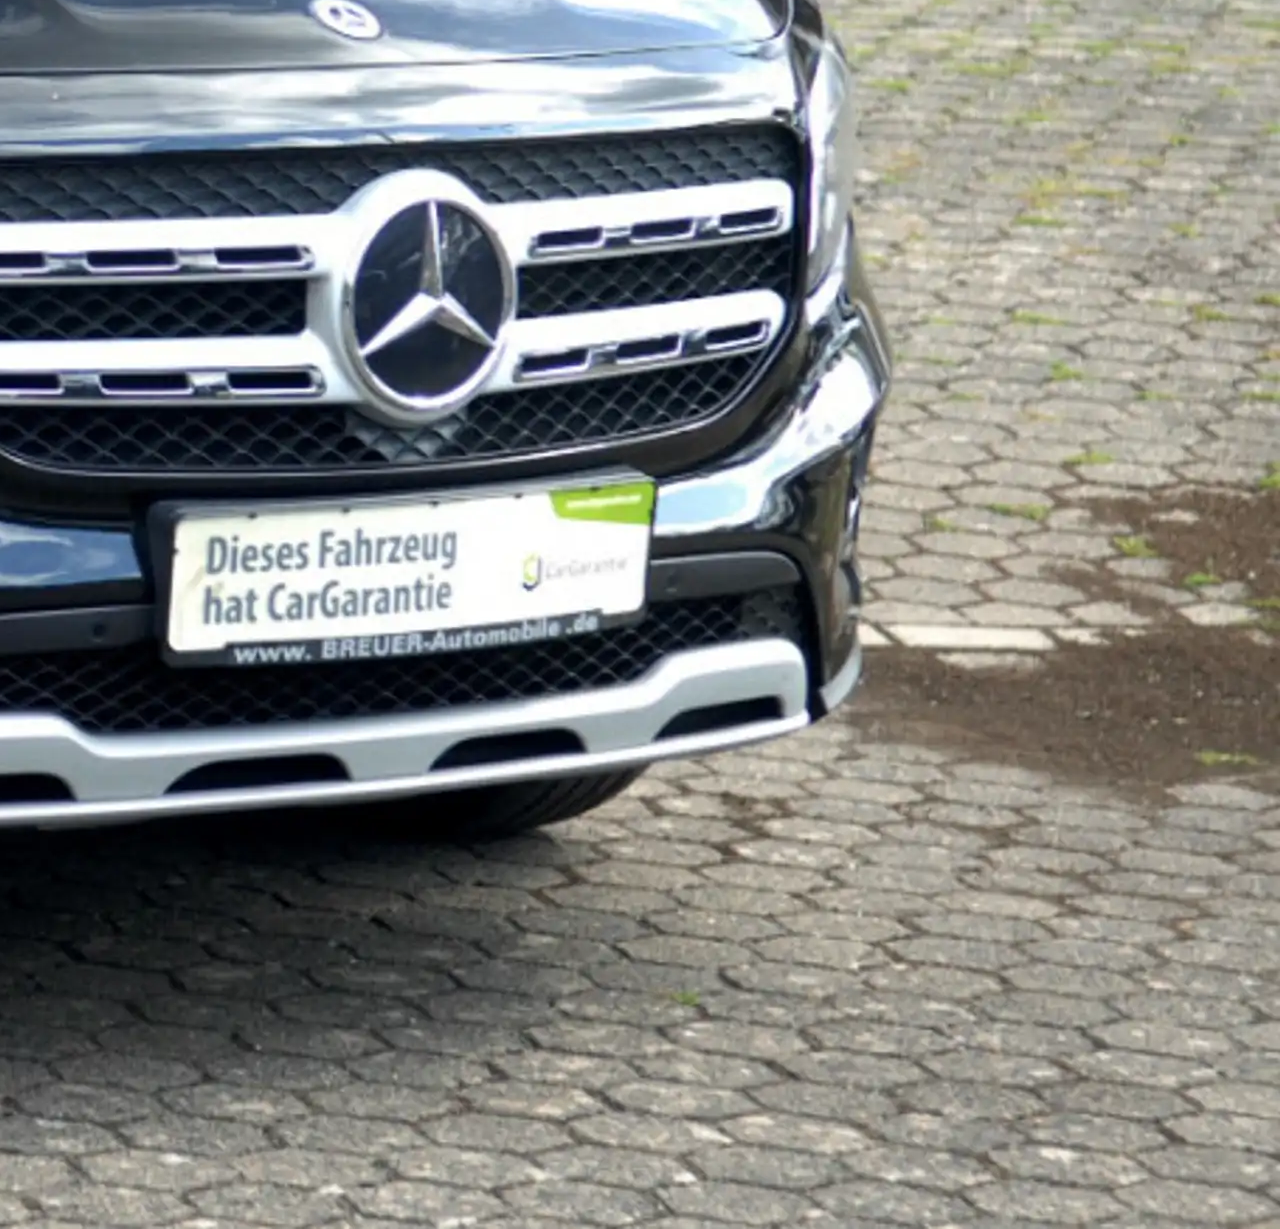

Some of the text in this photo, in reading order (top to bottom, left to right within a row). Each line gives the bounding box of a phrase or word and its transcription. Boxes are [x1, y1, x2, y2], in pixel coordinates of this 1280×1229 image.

[205, 527, 458, 575] Dieses Fahrzeug
[202, 573, 452, 625] hat CarGarantie
